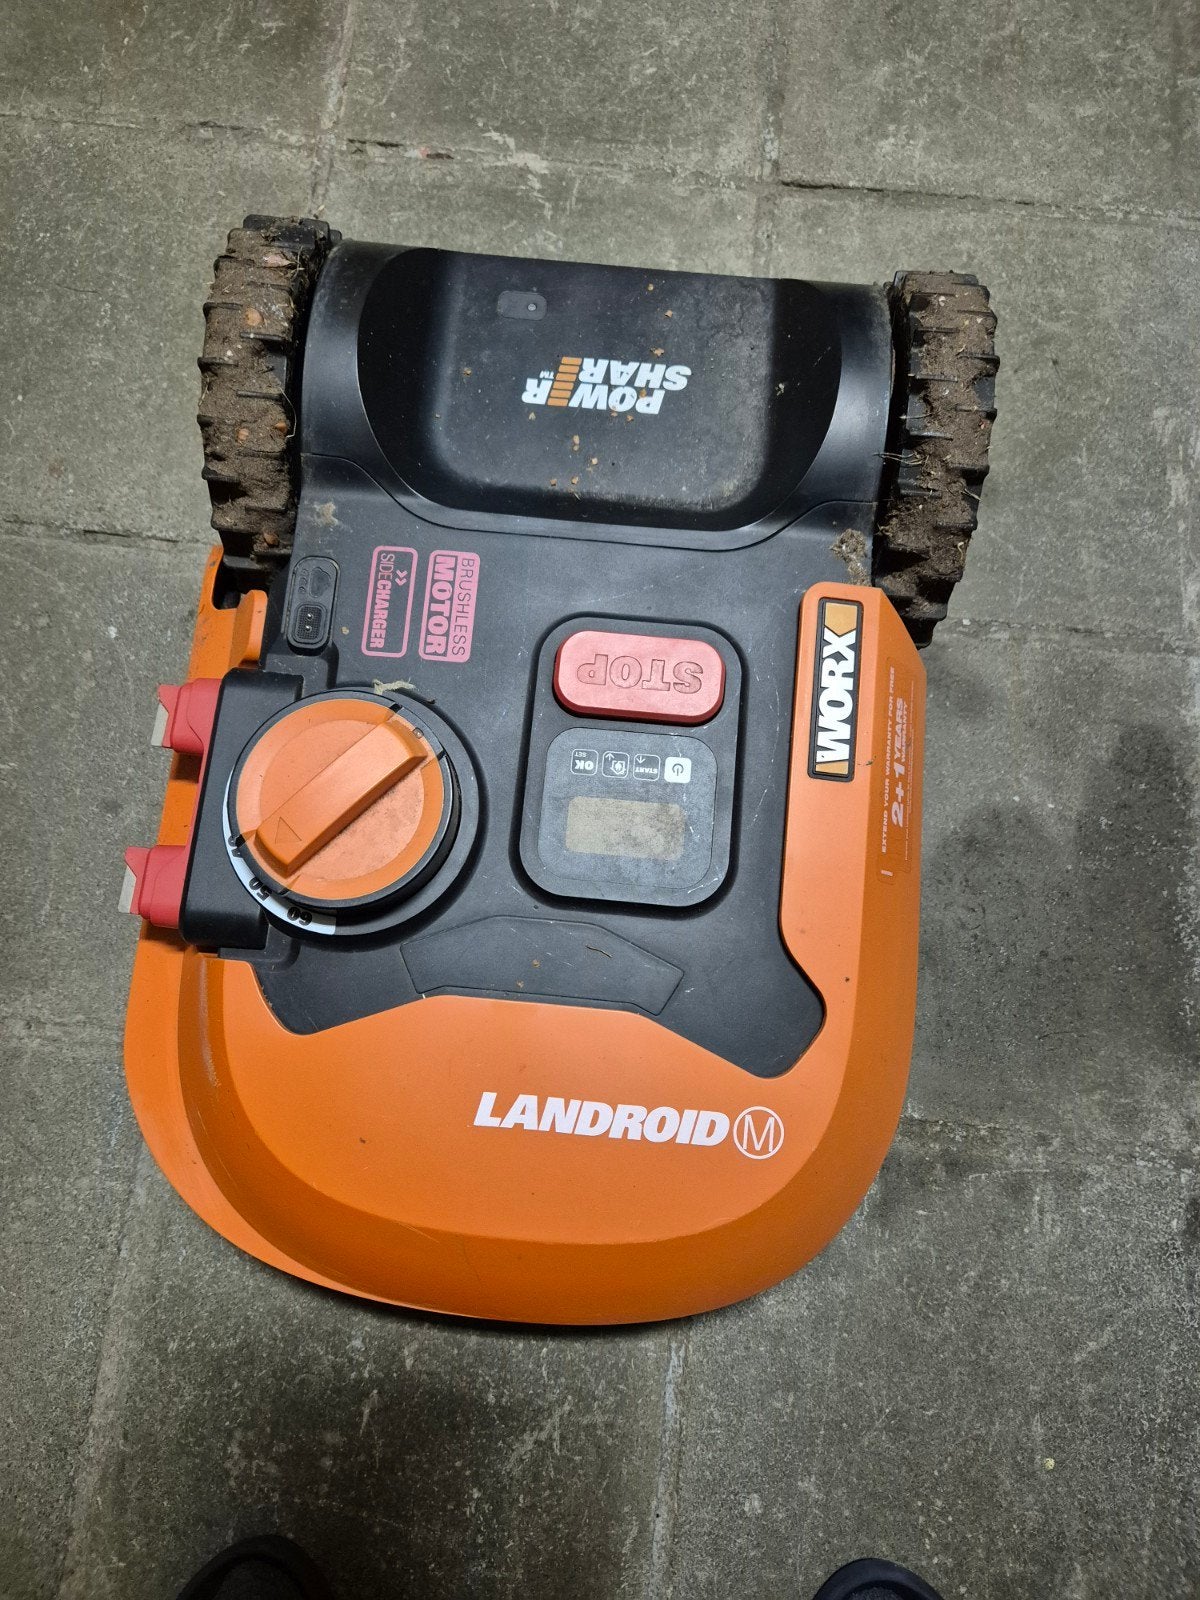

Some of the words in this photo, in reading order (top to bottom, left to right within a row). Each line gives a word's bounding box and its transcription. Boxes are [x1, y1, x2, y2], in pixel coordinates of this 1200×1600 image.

[370, 552, 396, 649] SIDECHARGER
[425, 555, 456, 655] MOTOR
[451, 557, 476, 656] BRUSHLESS
[576, 653, 704, 695] STOP
[815, 626, 857, 763] WORX
[893, 696, 904, 760] YEARS
[900, 701, 908, 762] WARRANTY
[574, 759, 594, 771] OK
[634, 766, 658, 774] START
[881, 810, 889, 853] EXTEND
[885, 718, 893, 776] WARRANTY
[248, 877, 272, 901] 50
[287, 906, 313, 926] 60
[473, 1091, 730, 1147] LANDROID
[740, 1112, 776, 1154] M
